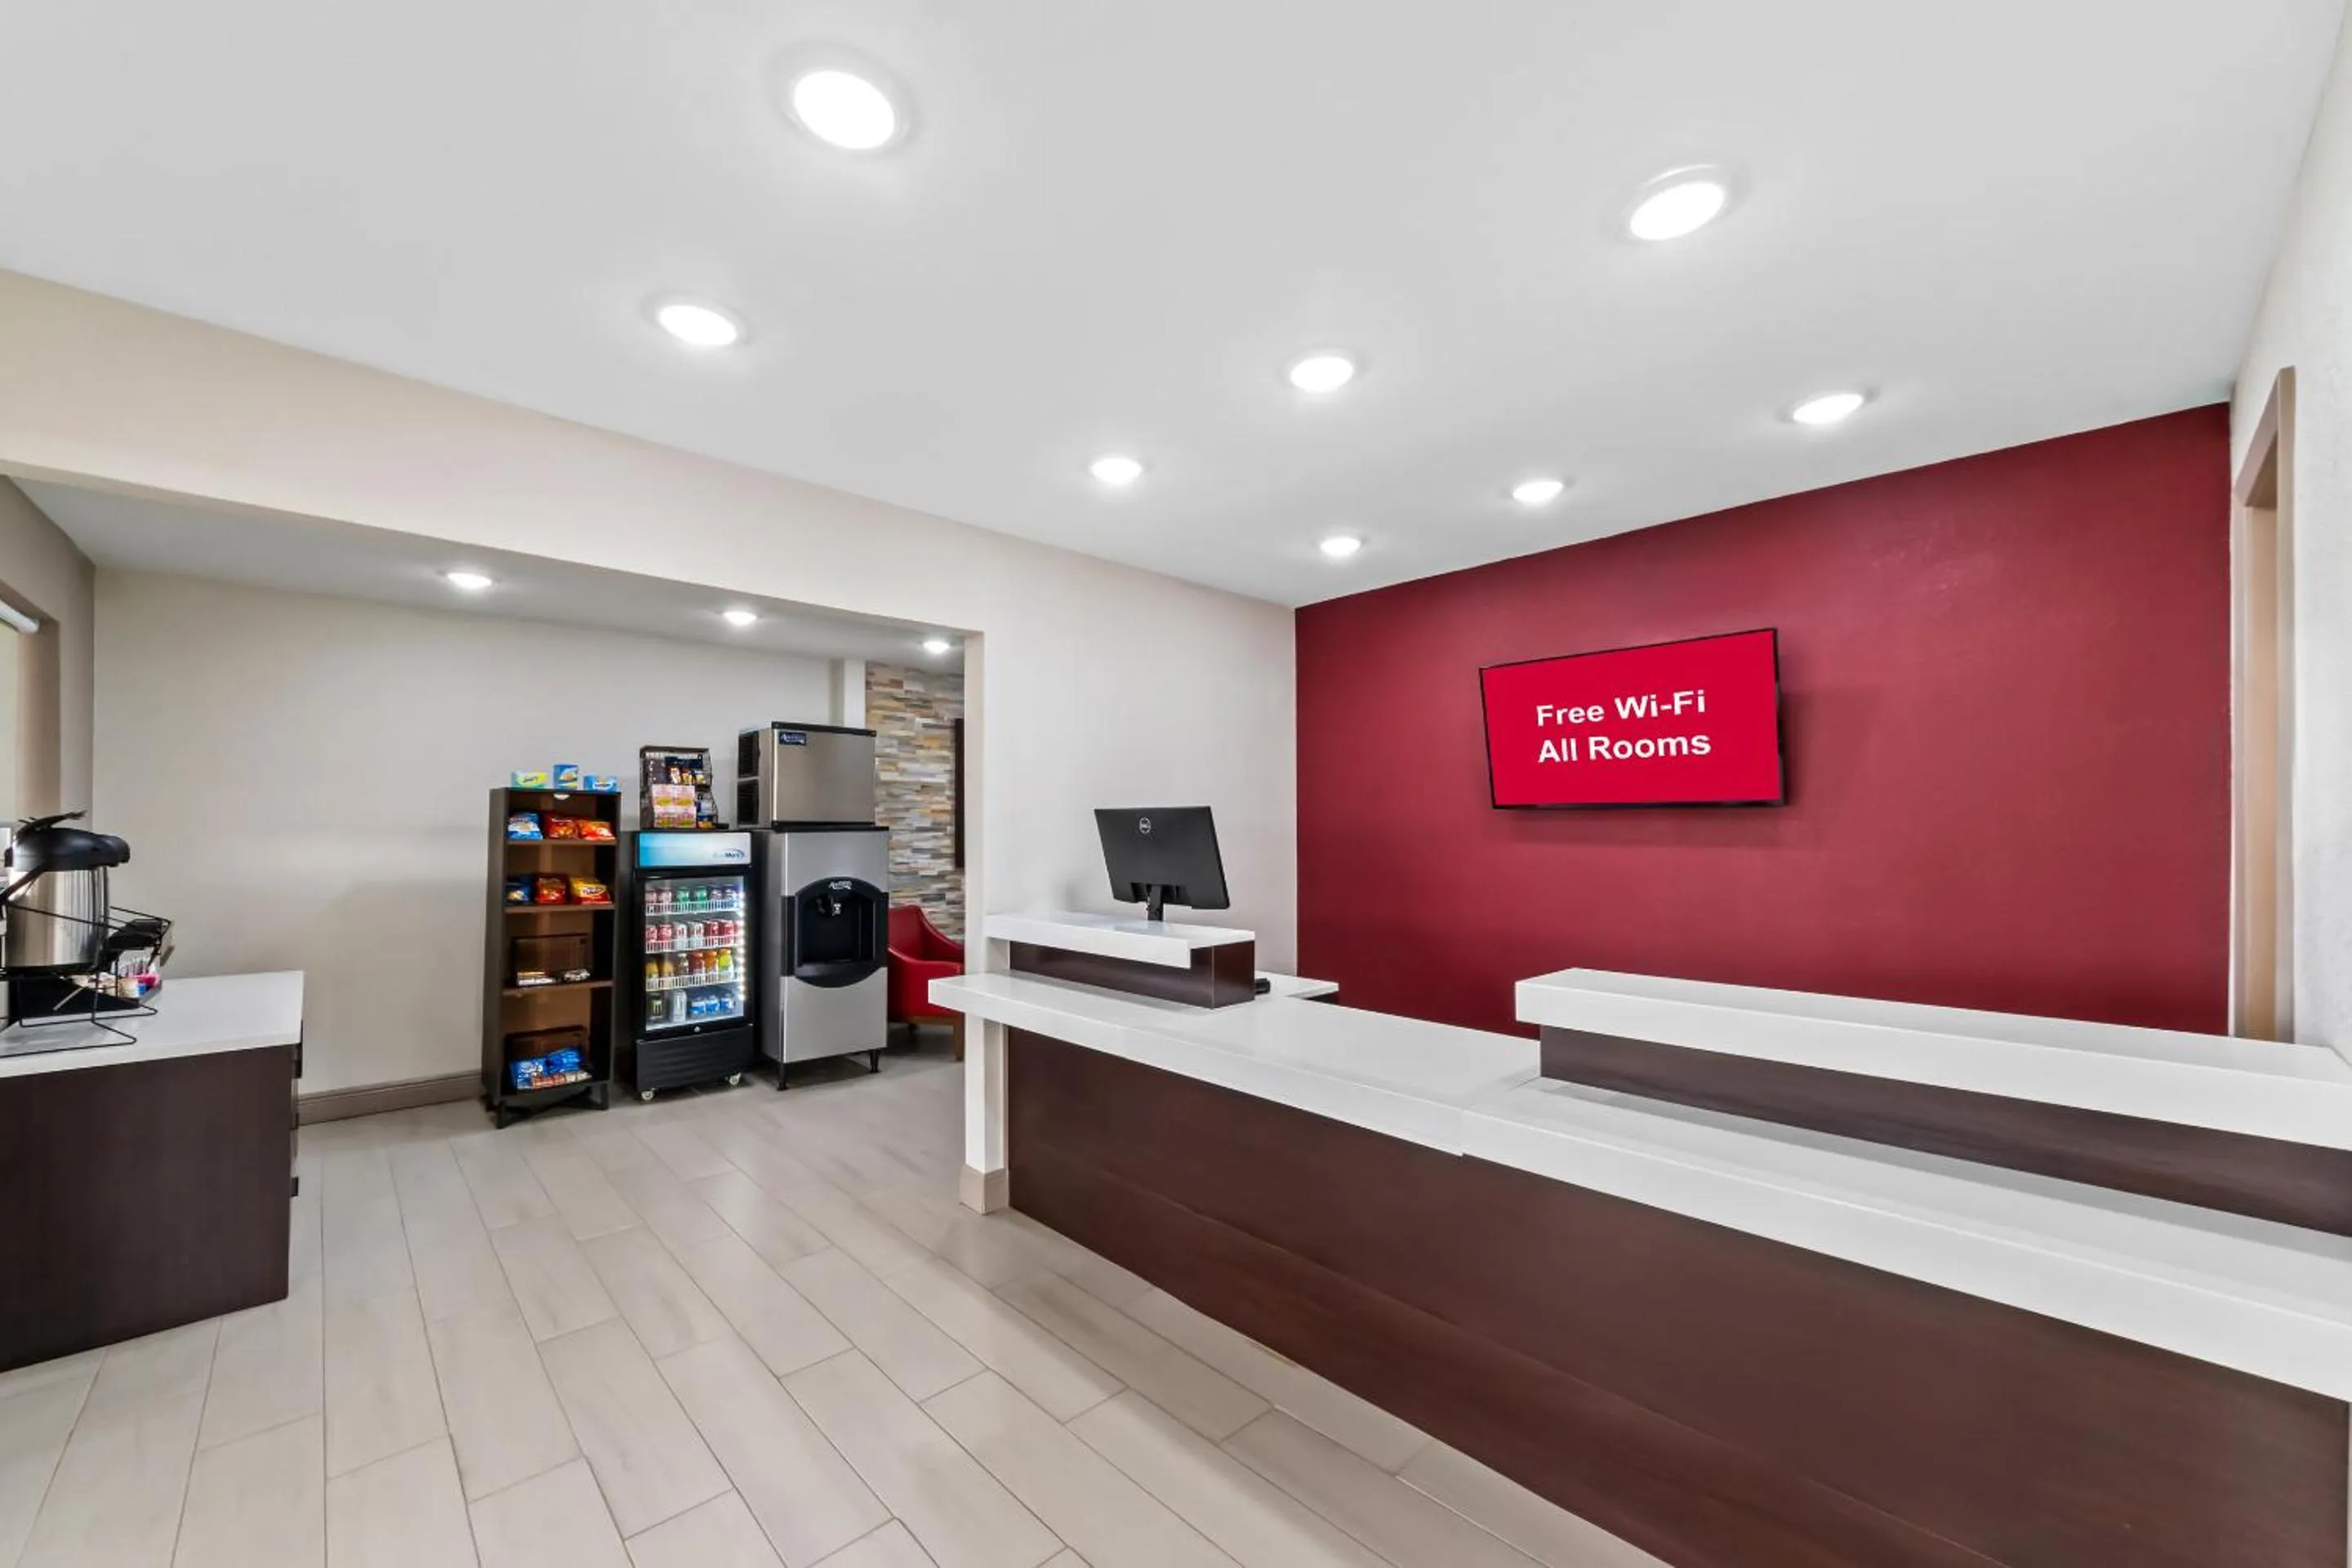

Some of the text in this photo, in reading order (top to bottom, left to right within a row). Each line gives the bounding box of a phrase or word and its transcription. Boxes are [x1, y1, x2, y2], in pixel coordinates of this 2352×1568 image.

[1536, 689, 1705, 727] Free Wi-Fi
[1538, 734, 1712, 763] All Rooms
